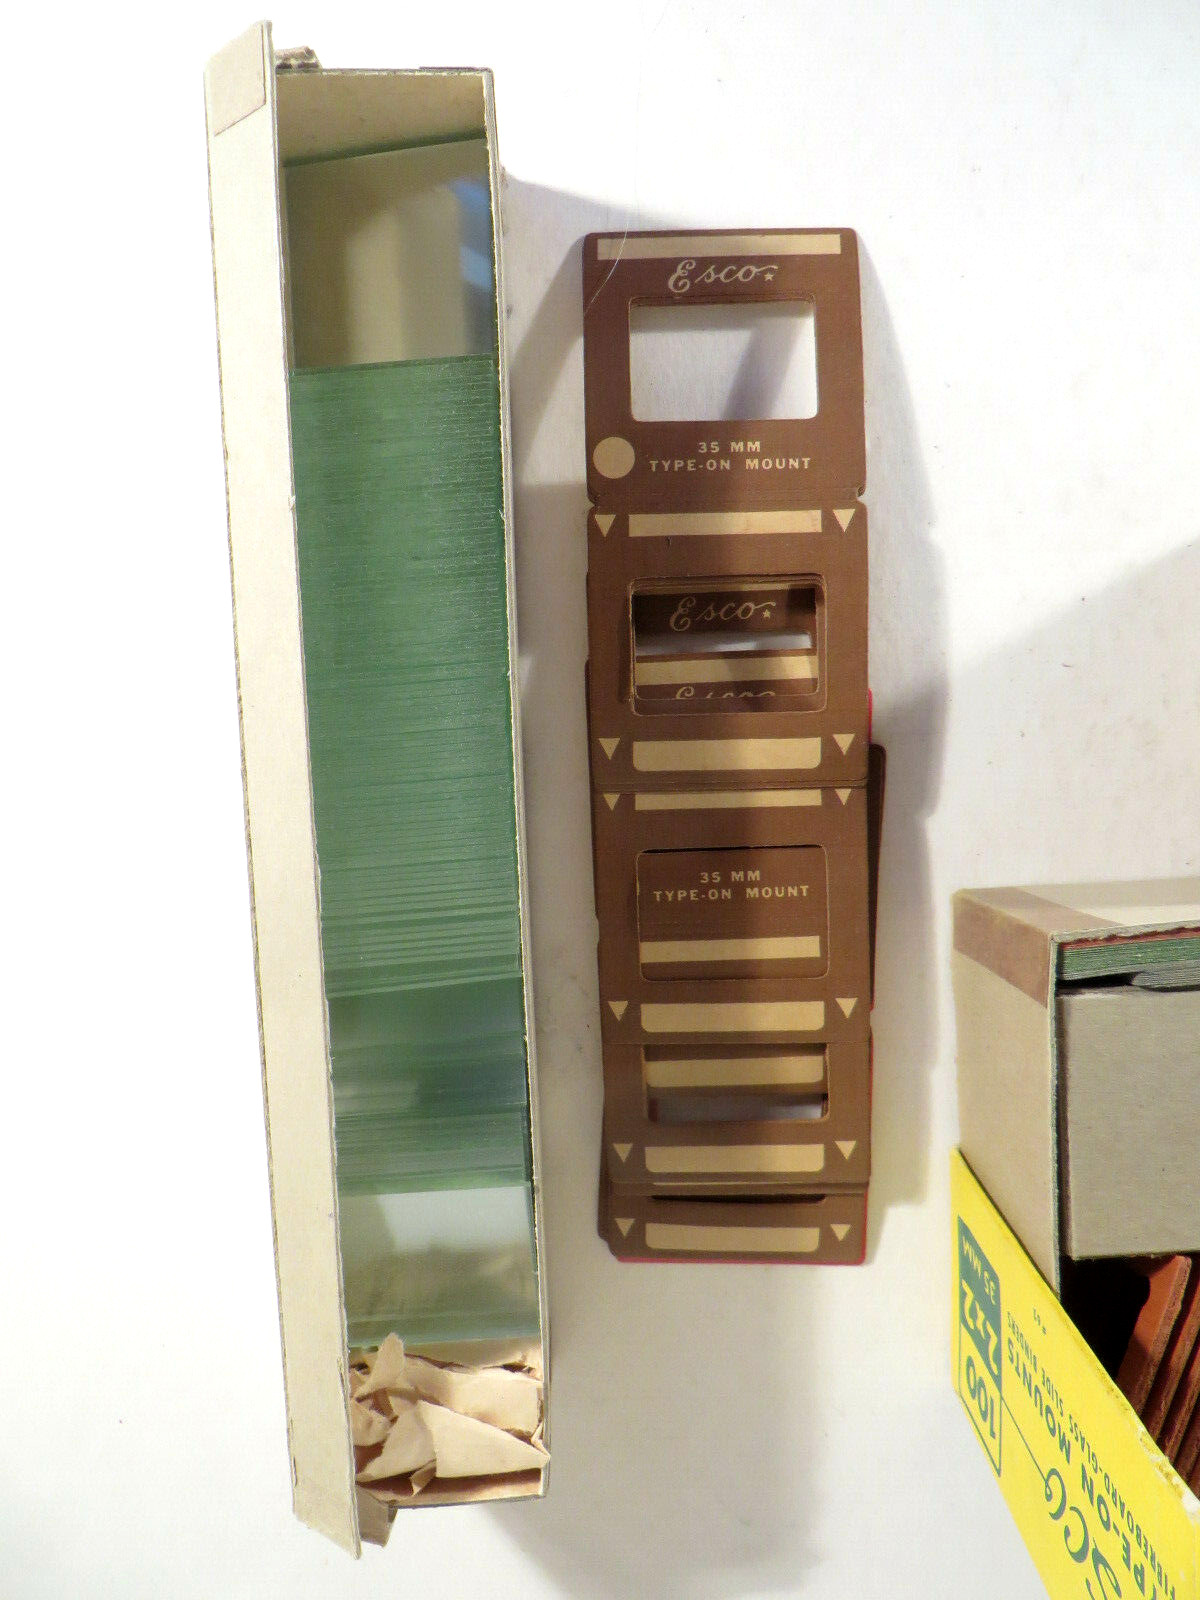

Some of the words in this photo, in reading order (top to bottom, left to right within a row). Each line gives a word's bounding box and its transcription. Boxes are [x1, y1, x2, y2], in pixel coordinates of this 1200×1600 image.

[668, 259, 778, 293] Esco
[649, 458, 731, 472] TYPE-ON
[745, 457, 811, 470] MOUNT
[698, 441, 720, 453] 35
[730, 440, 761, 453] MM
[669, 596, 776, 632] Esco
[653, 888, 732, 902] TYPE-ON
[746, 885, 810, 898] MOUNT
[700, 871, 720, 883] 35
[731, 870, 761, 882] MM
[962, 1235, 982, 1278] MM
[983, 1269, 996, 1306] 35
[1006, 1310, 1038, 1374] BINDERS
[965, 1355, 996, 1440] 100
[1007, 1337, 1071, 1465] MOUNTS
[1041, 1367, 1065, 1418] SLIDE
